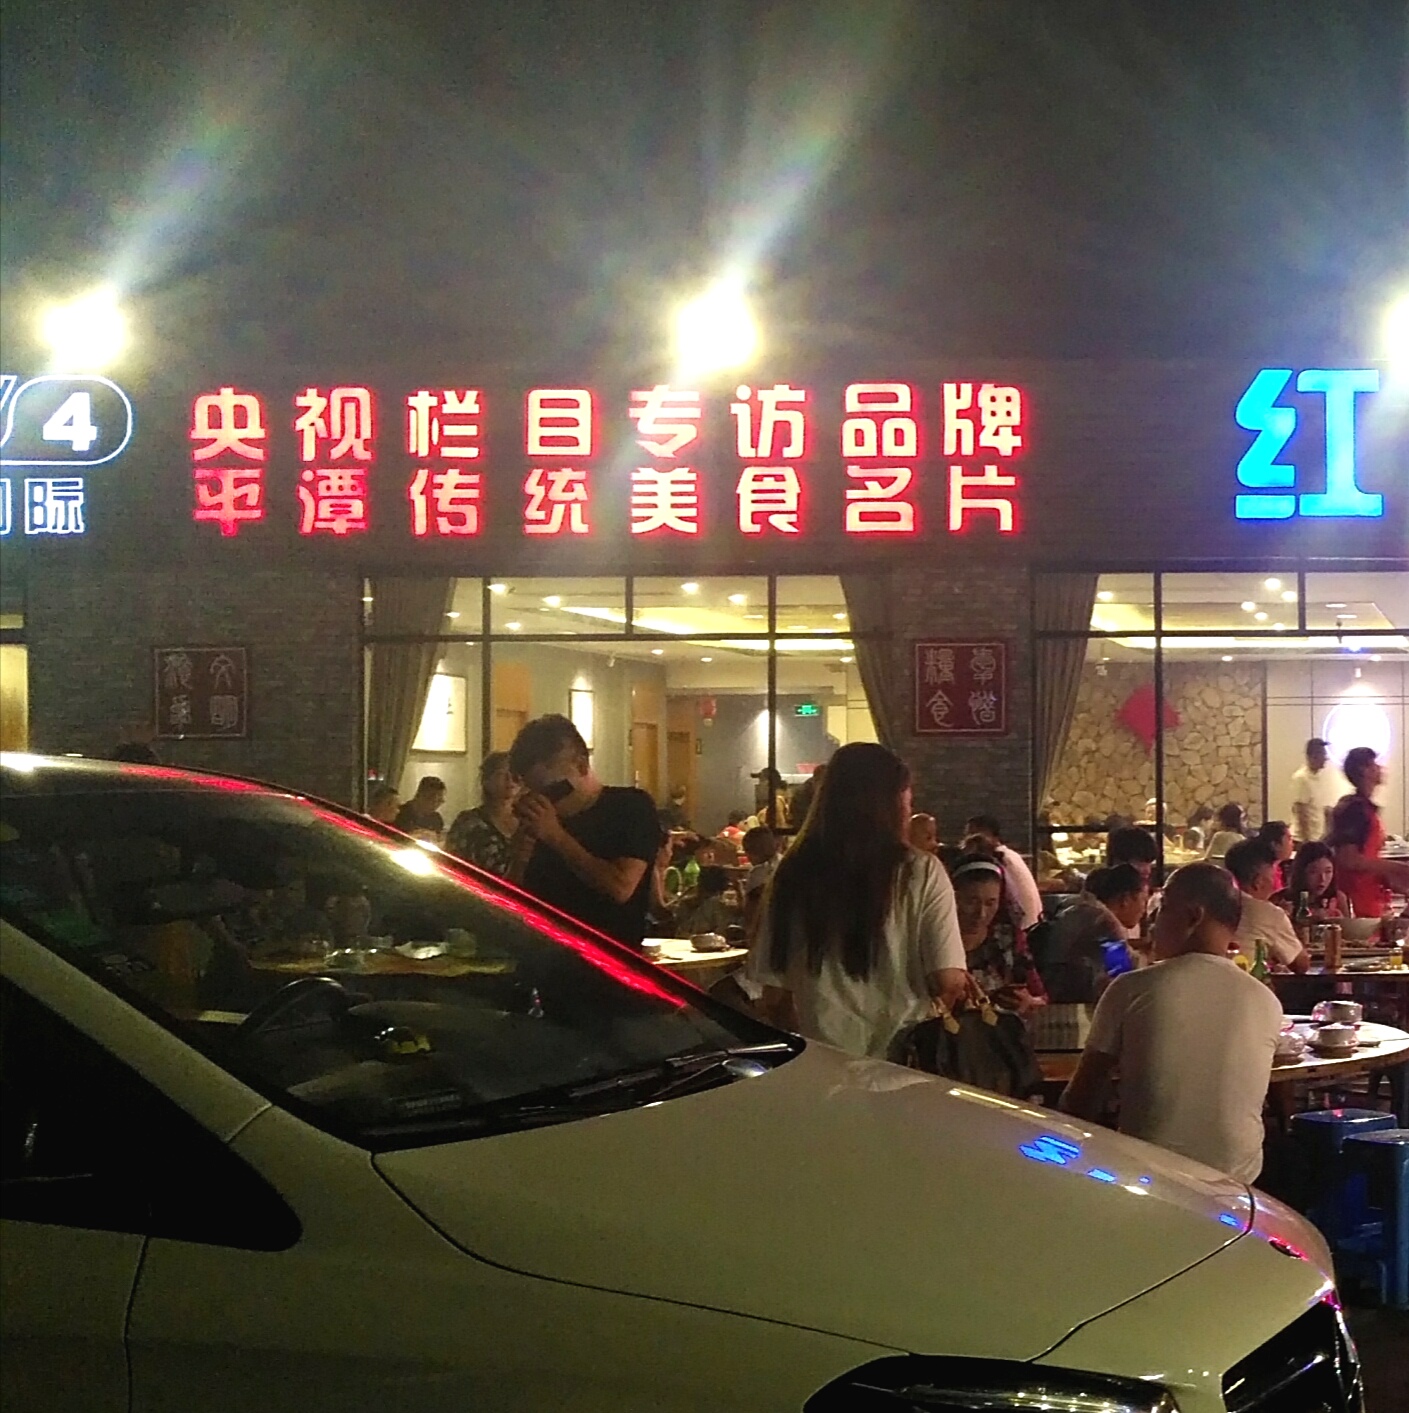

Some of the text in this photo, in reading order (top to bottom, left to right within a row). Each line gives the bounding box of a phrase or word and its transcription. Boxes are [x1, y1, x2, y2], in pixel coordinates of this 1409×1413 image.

[191, 383, 1023, 462] 央视栏目专访品牌
[0, 477, 85, 535] 际
[194, 465, 1017, 535] 平潭传统美食名片
